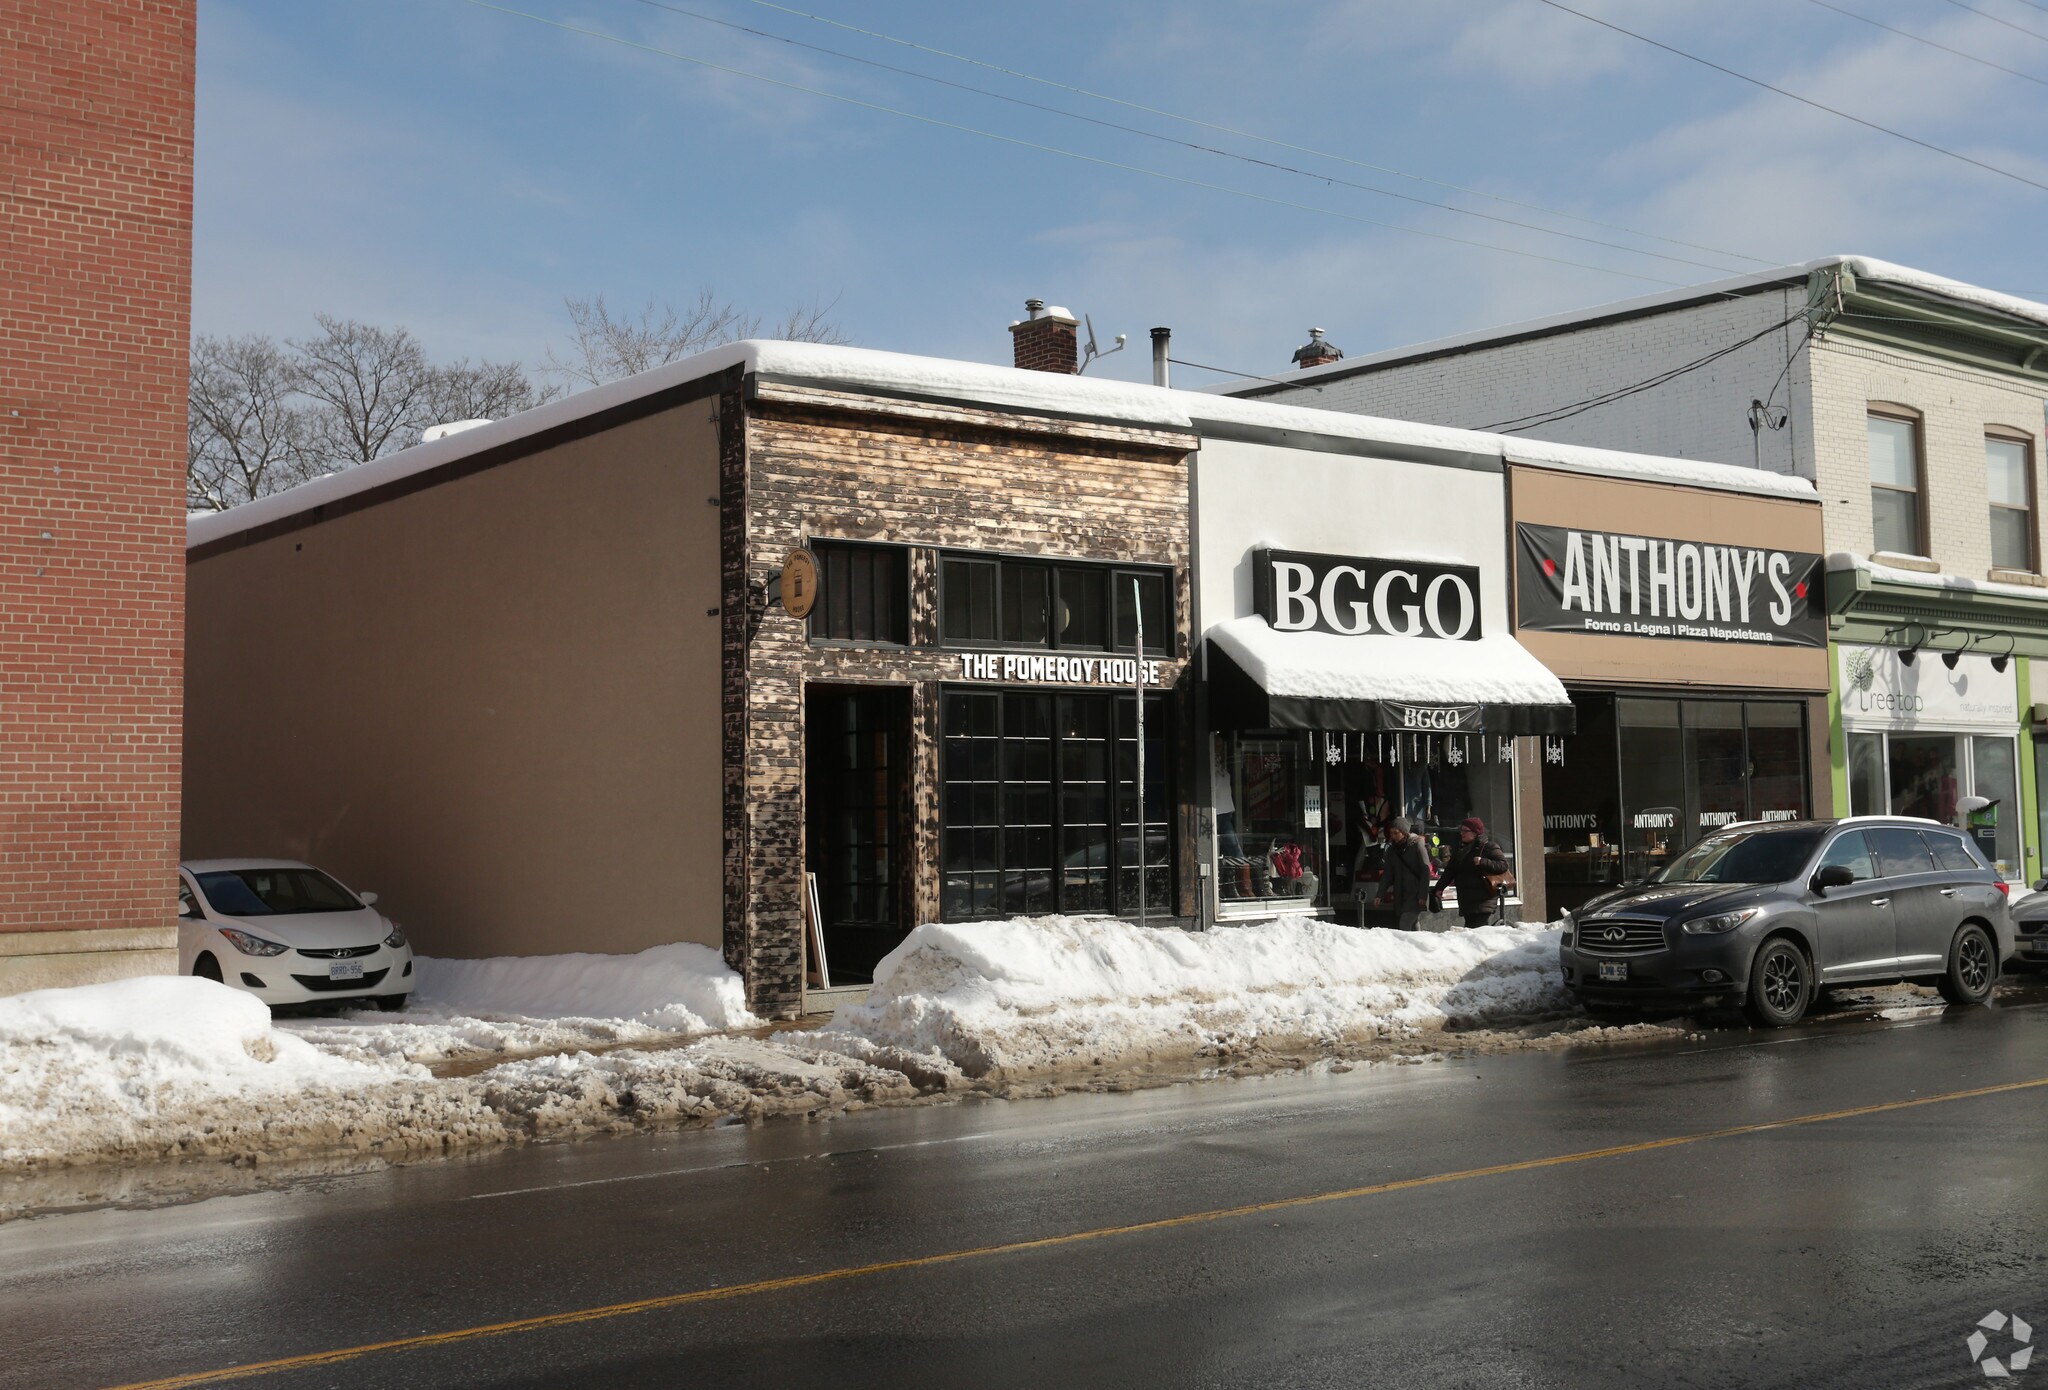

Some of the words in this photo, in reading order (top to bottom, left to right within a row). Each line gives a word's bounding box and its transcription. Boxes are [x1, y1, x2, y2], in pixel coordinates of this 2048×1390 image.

[1561, 531, 1792, 626] ANTHONY'S
[1271, 560, 1475, 640] BGGO
[1584, 618, 1621, 632] Forno
[1623, 623, 1632, 633] a
[1633, 621, 1671, 636] Legna
[1678, 624, 1709, 638] Pizza
[1710, 626, 1773, 642] Napoletana
[961, 653, 998, 679] THE
[1002, 655, 1095, 683] POMEROY
[1099, 659, 1160, 684] HOUSE
[1403, 707, 1461, 729] BGGO
[1634, 813, 1674, 828] ANTHONY'S
[1700, 811, 1737, 826] ANTHONY'S
[1761, 810, 1797, 821] ANTHONY'S
